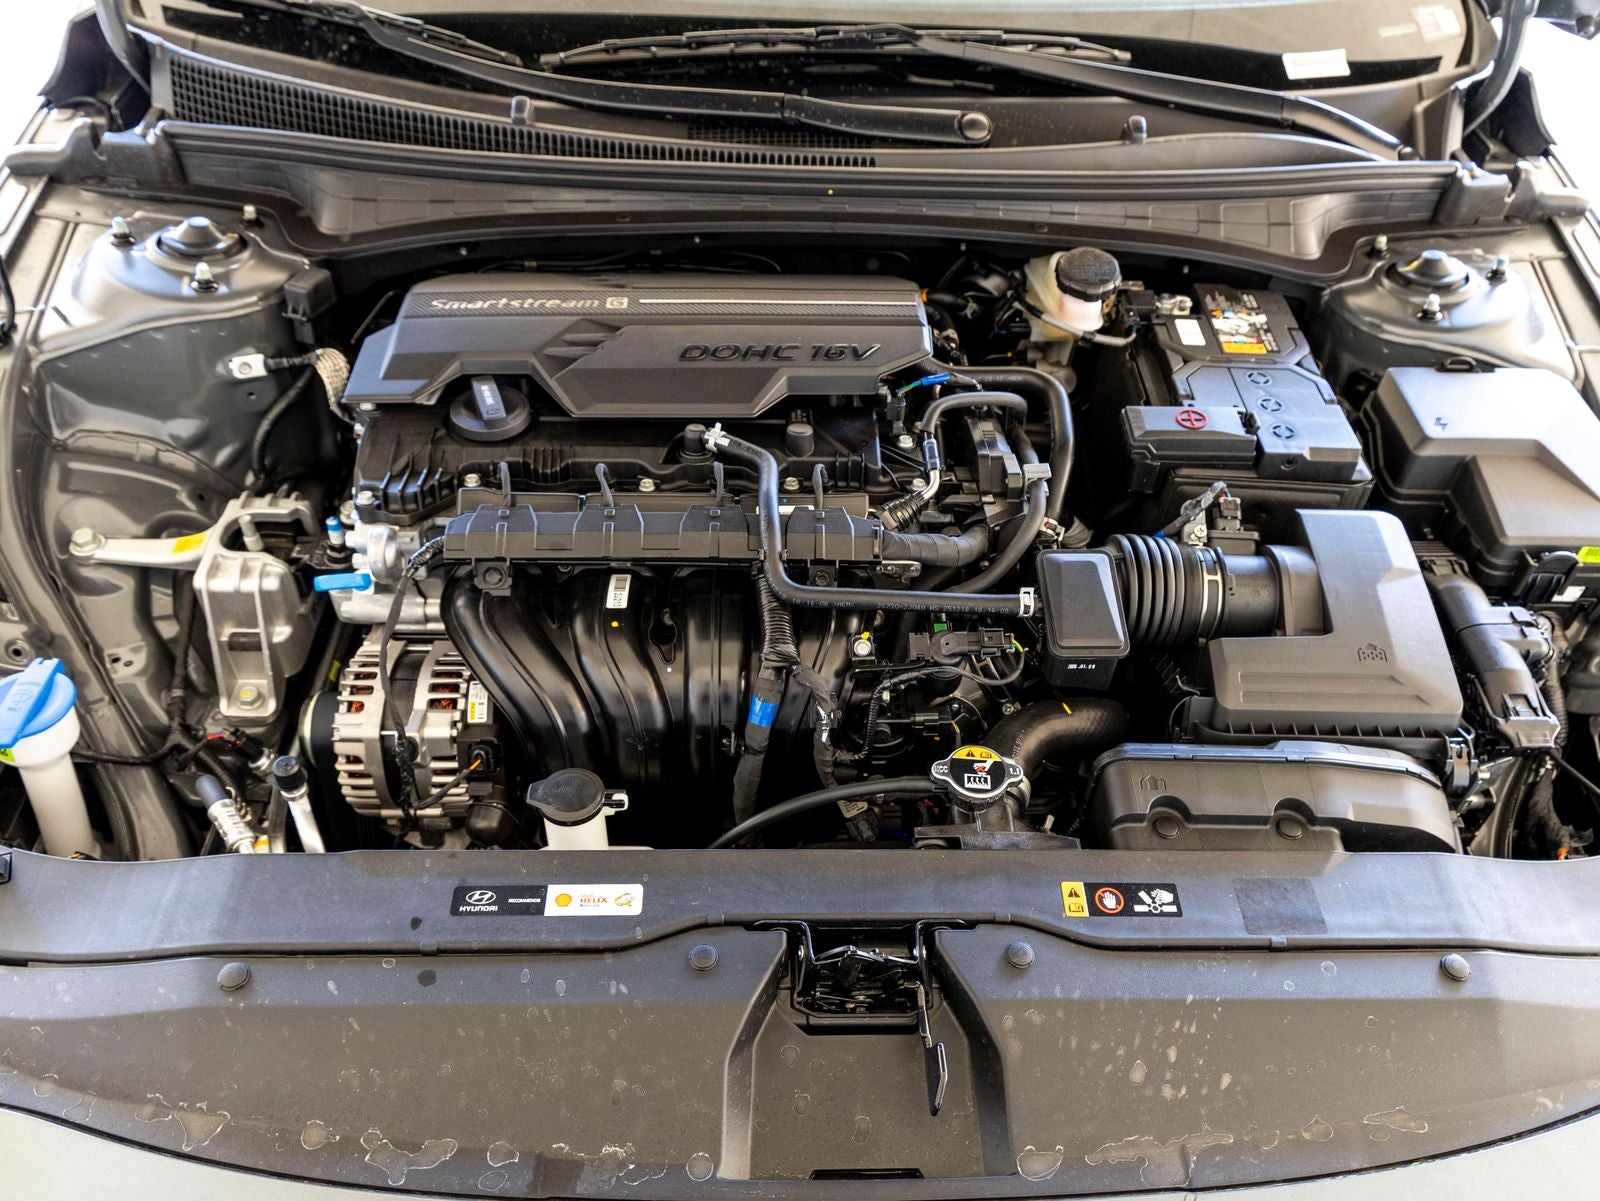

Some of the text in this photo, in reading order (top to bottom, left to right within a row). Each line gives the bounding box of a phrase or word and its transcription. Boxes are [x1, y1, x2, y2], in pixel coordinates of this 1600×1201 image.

[431, 297, 628, 309] Smartstream G
[678, 343, 882, 361] DOHC 16V
[580, 896, 608, 904] HELIX
